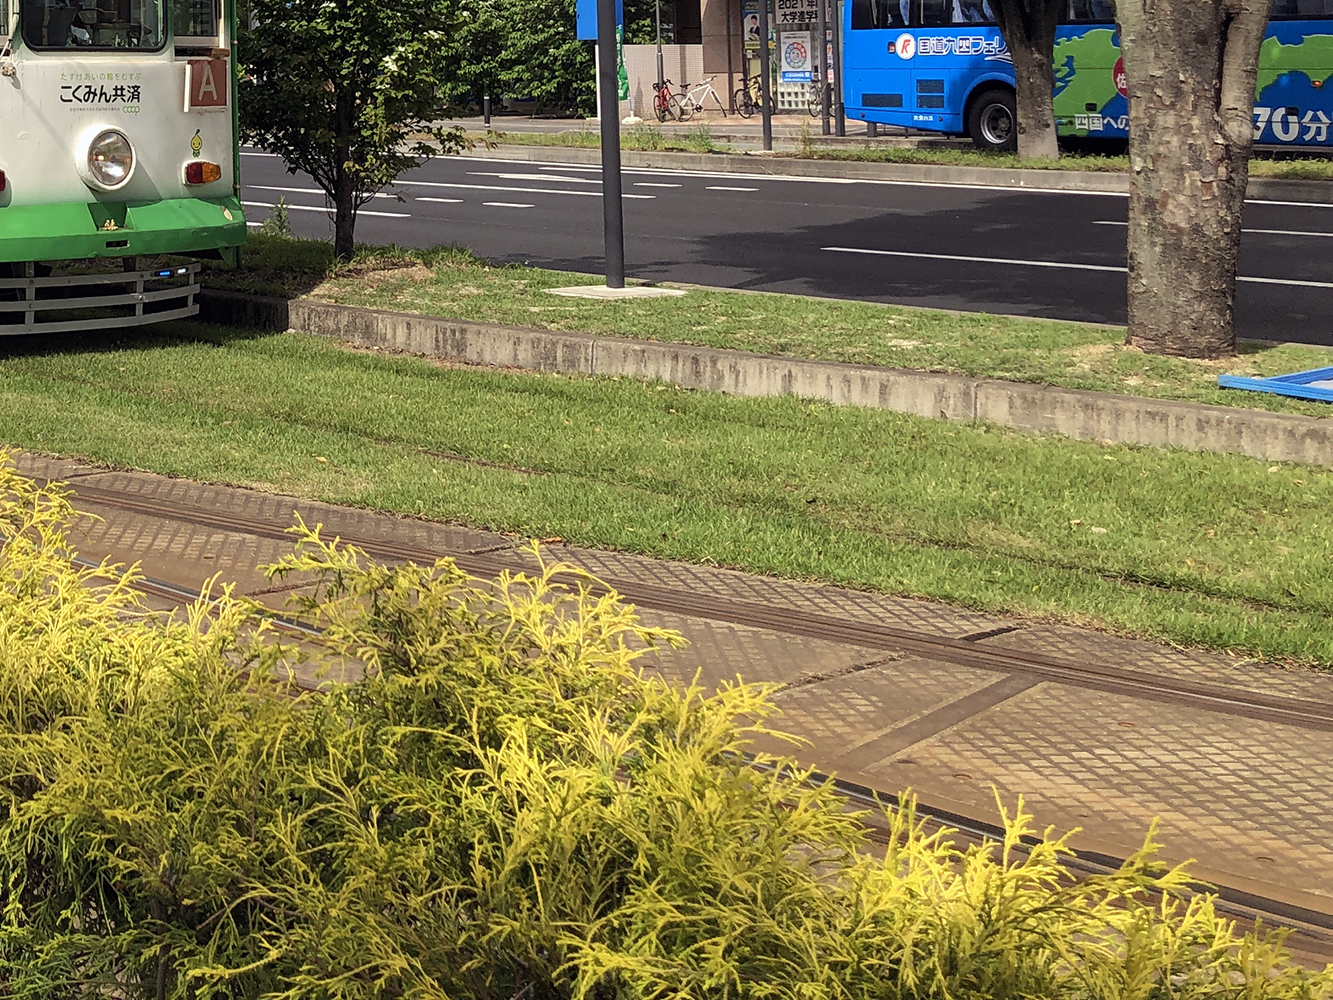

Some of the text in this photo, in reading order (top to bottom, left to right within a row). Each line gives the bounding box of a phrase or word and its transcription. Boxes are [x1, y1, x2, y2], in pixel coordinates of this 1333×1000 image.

[198, 64, 218, 101] A
[60, 85, 141, 103] こくみん共済
[1075, 113, 1130, 131] 四国への
